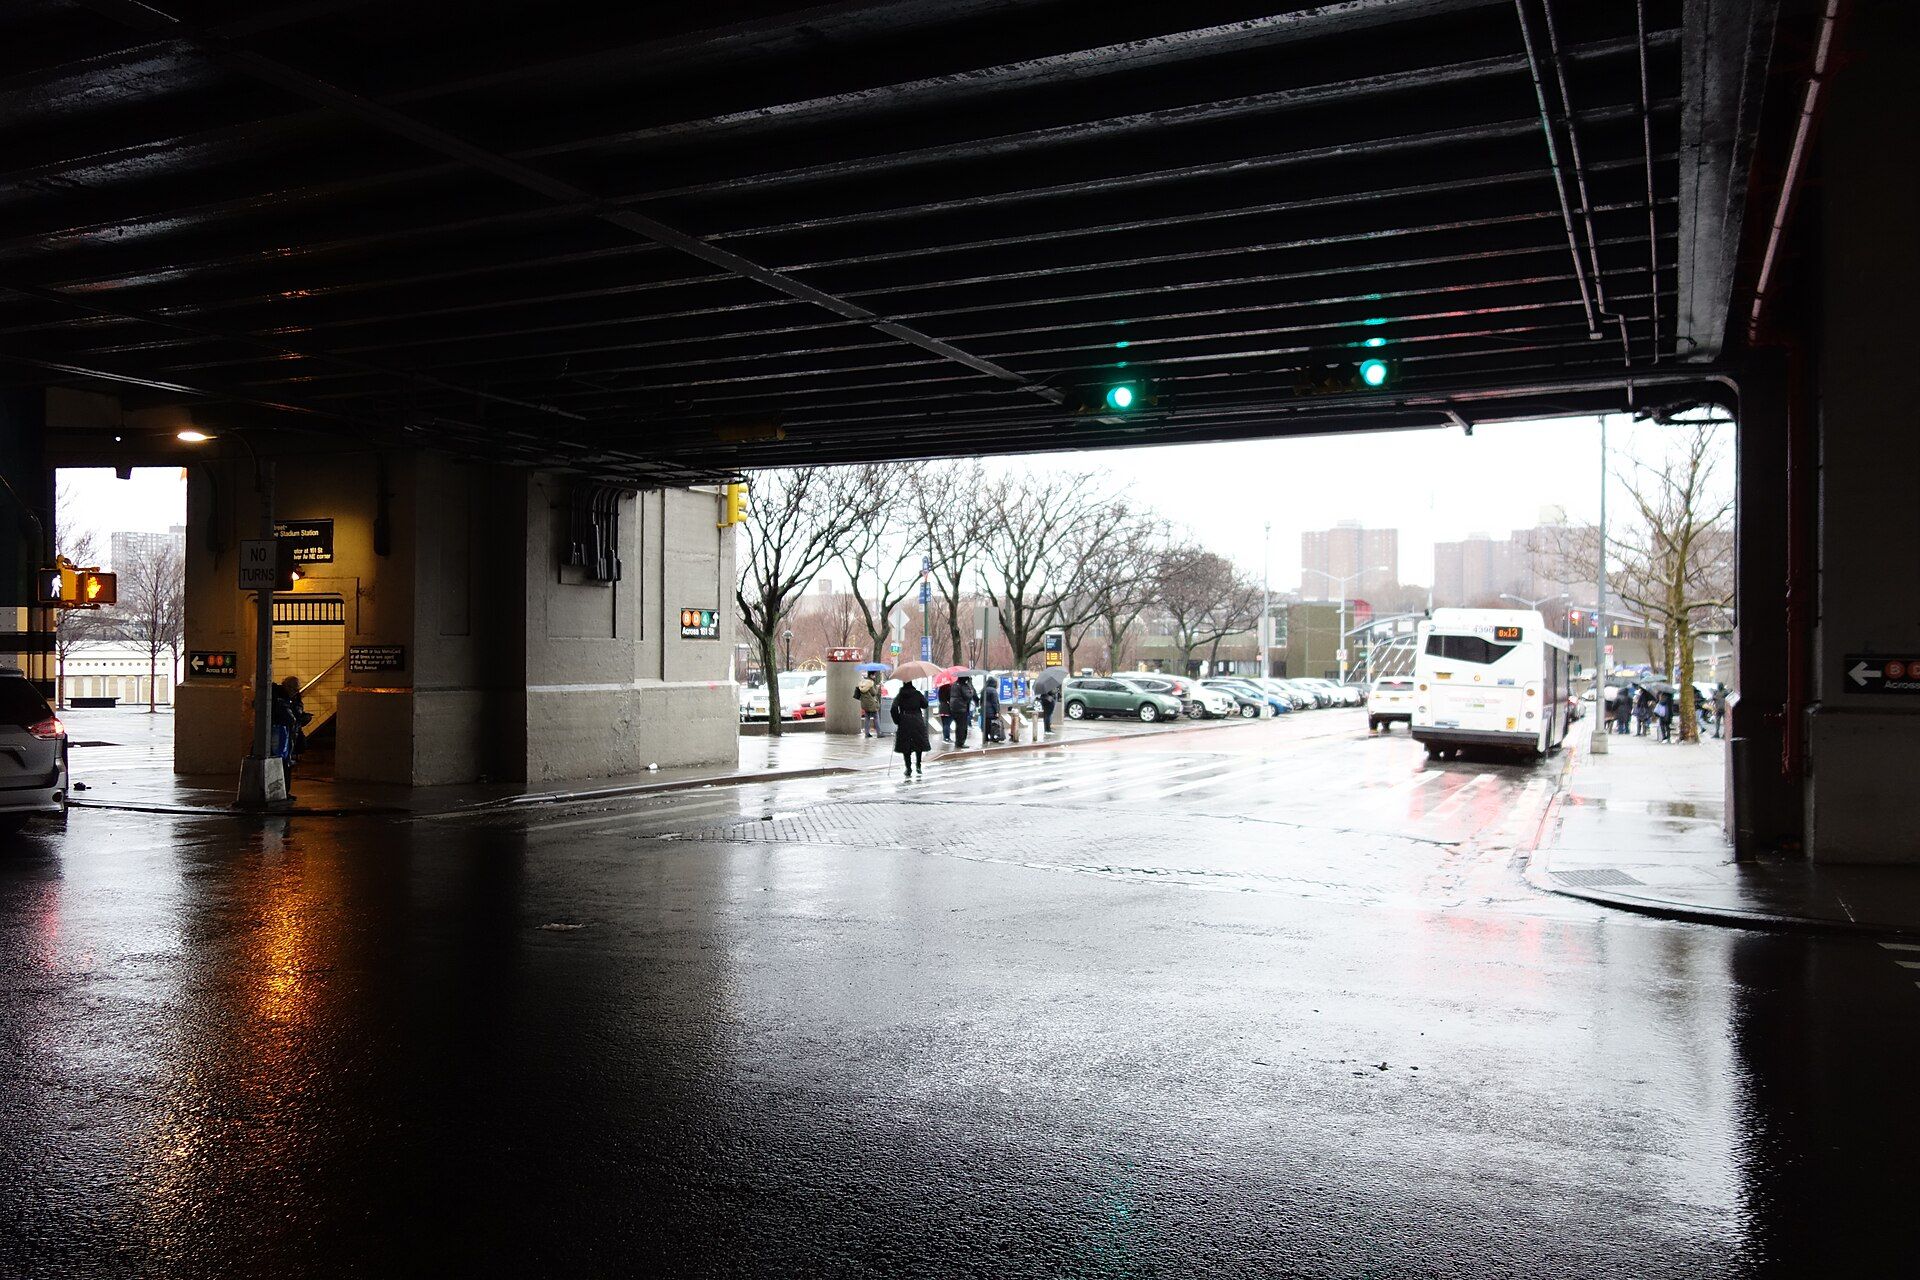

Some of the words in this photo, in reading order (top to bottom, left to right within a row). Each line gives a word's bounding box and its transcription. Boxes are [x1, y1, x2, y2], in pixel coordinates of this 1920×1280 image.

[250, 548, 267, 561] NO
[241, 568, 275, 581] TURNS
[682, 627, 700, 635] Across
[700, 627, 708, 635] 161
[708, 627, 715, 635] St
[1884, 680, 1920, 689] Across
